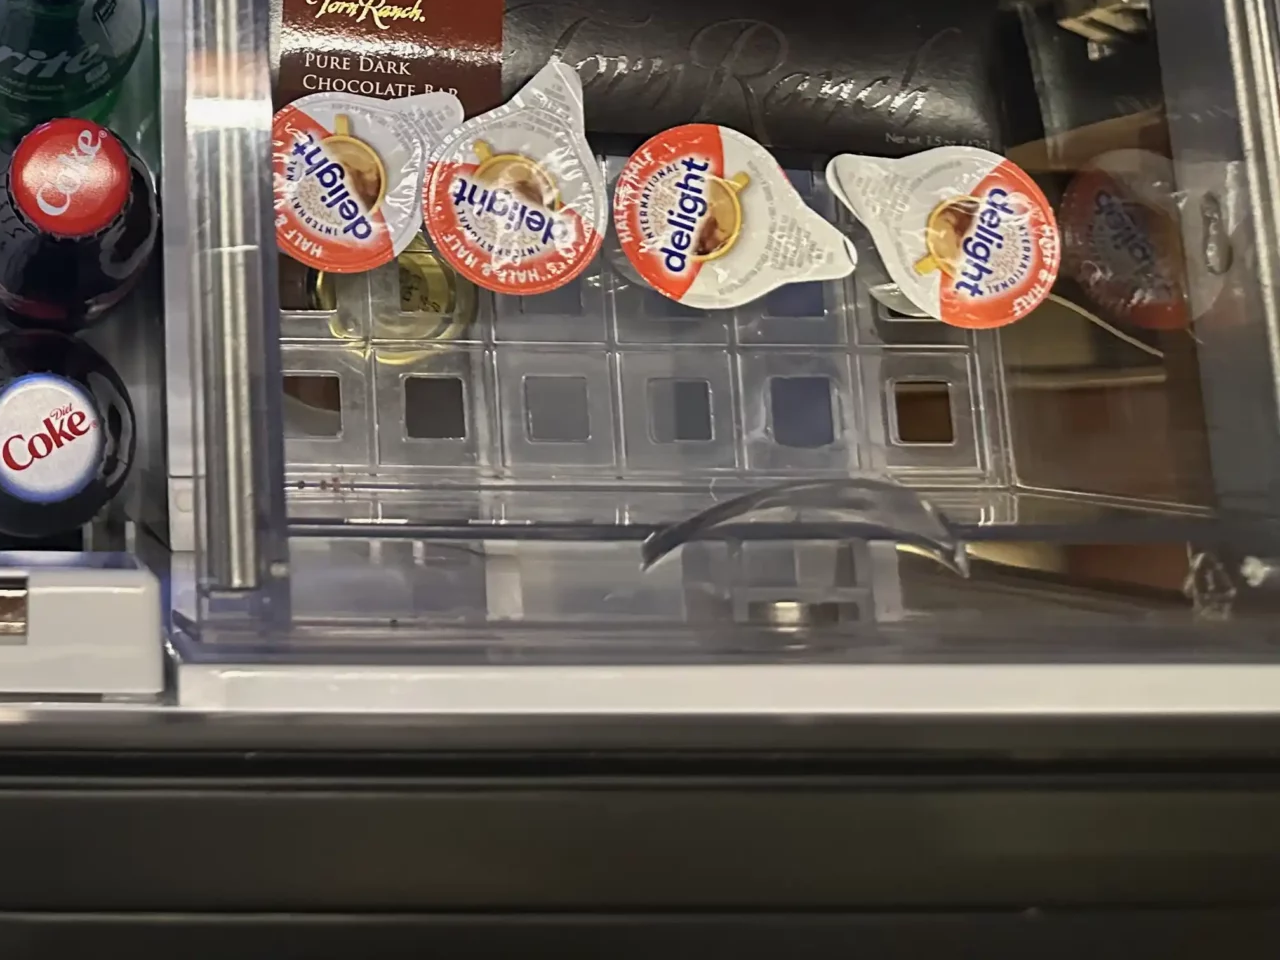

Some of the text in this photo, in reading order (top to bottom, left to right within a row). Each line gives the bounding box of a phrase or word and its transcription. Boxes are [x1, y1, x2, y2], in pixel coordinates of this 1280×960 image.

[304, 53, 412, 76] PURE DARK
[302, 74, 416, 97] CHOCOLATE
[36, 129, 102, 216] Coke
[621, 146, 656, 184] HALF
[286, 160, 340, 236] INTERNATNAL
[292, 132, 373, 240] delight
[639, 162, 680, 250] INTERNATIONAL
[659, 157, 709, 273] delight
[284, 228, 325, 258] HALF
[443, 231, 482, 270] HALF
[955, 187, 1014, 298] delight
[498, 260, 541, 285] HALF
[1012, 283, 1048, 317] HALF
[50, 402, 73, 421] Diet
[2, 410, 92, 471] Coke
